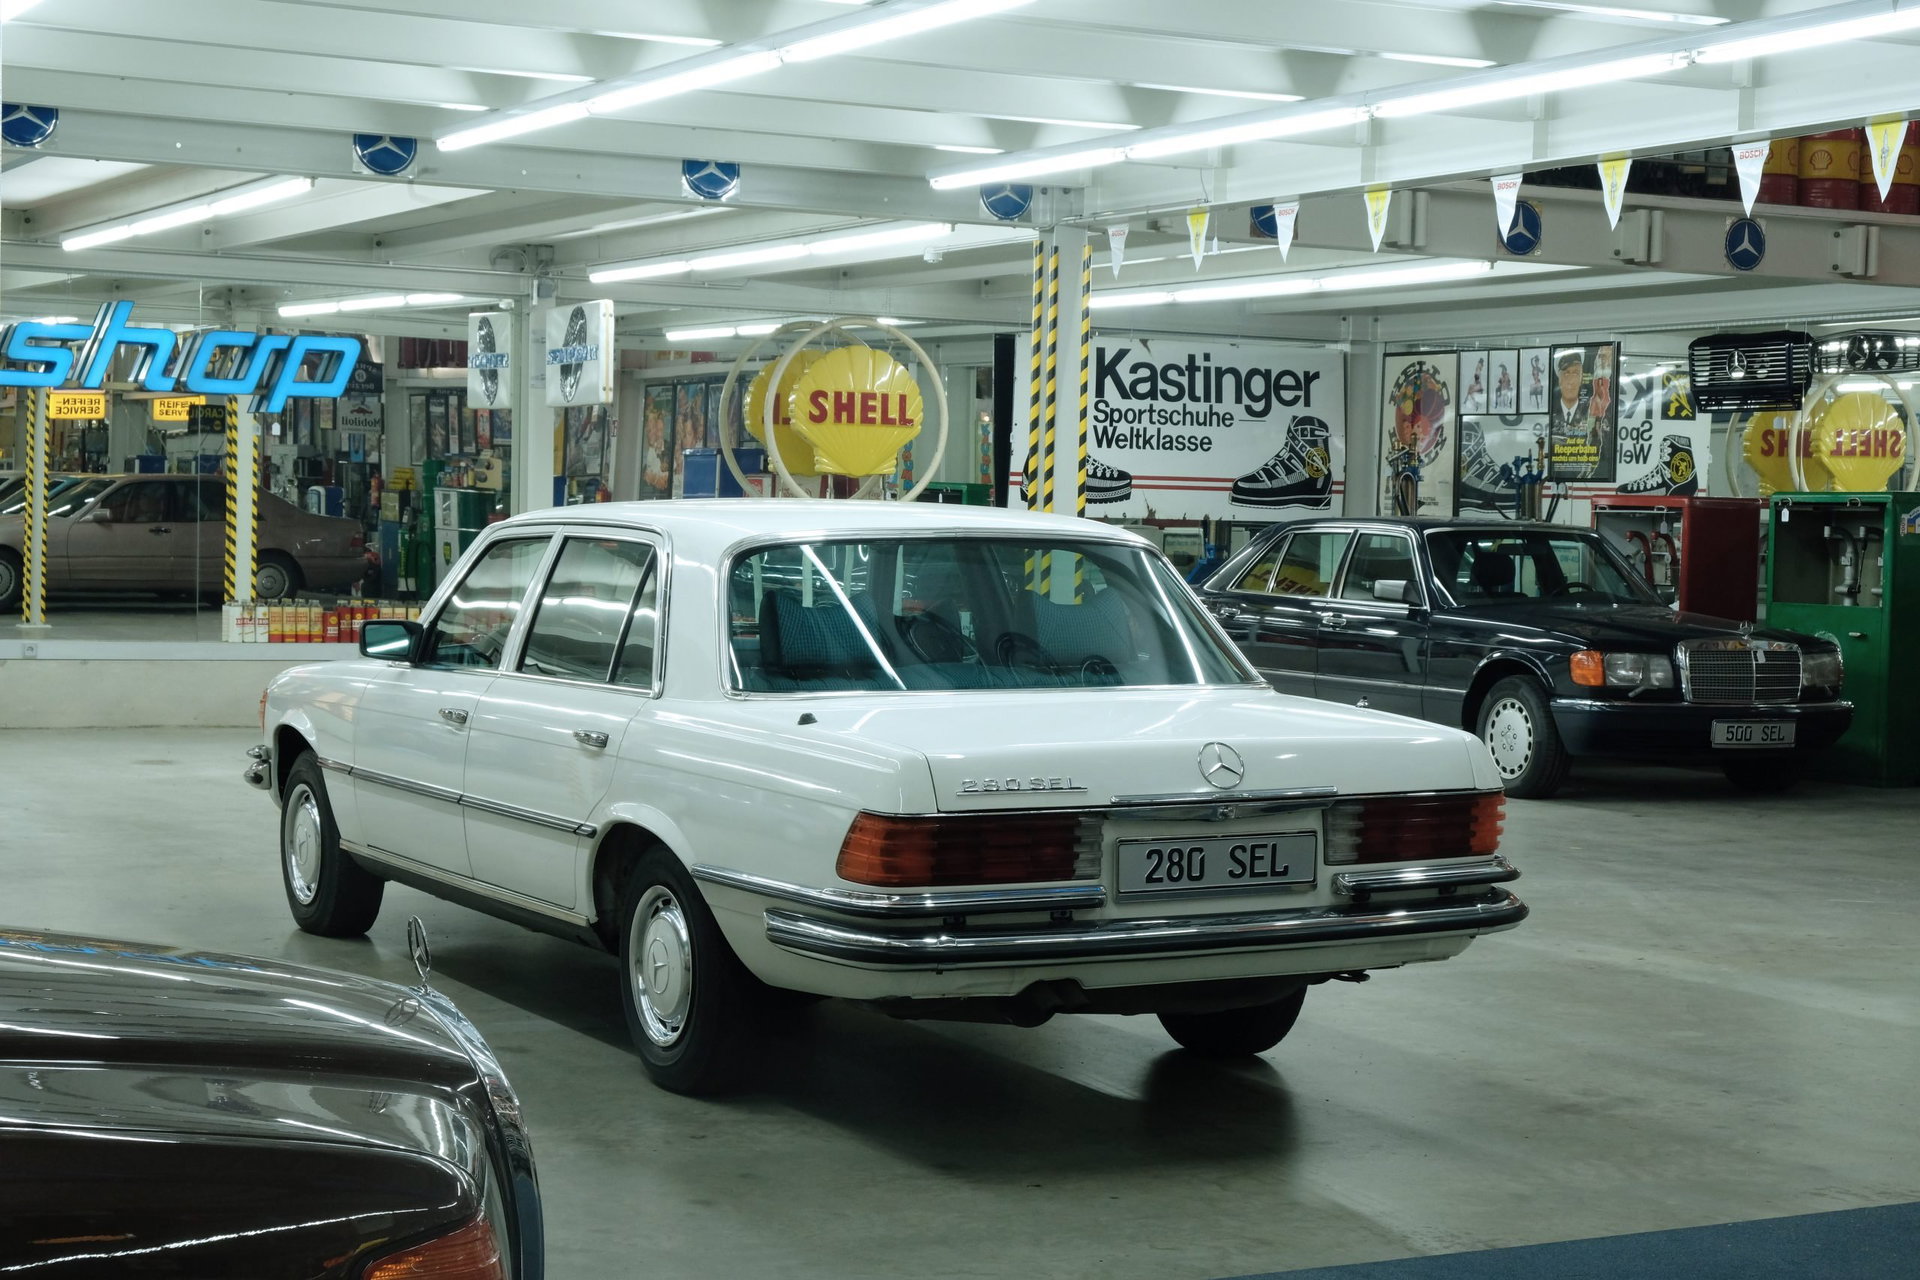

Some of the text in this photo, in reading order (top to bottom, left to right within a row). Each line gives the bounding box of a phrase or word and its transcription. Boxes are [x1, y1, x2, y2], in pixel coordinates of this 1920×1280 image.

[1739, 149, 1764, 160] BOSCH
[1497, 181, 1518, 190] BOSCH
[1278, 208, 1295, 216] BOSCH
[0, 300, 361, 413] shop
[1094, 347, 1320, 418] Kastinger
[808, 389, 914, 426] SHELL
[1093, 399, 1234, 427] Sportschuhe
[1093, 424, 1213, 452] Weltklasse
[1554, 444, 1597, 455] Reeperbahn
[1726, 725, 1785, 742] 500 SEL
[962, 777, 1082, 791] 280 SEL
[1145, 842, 1290, 884] 280 SEL
